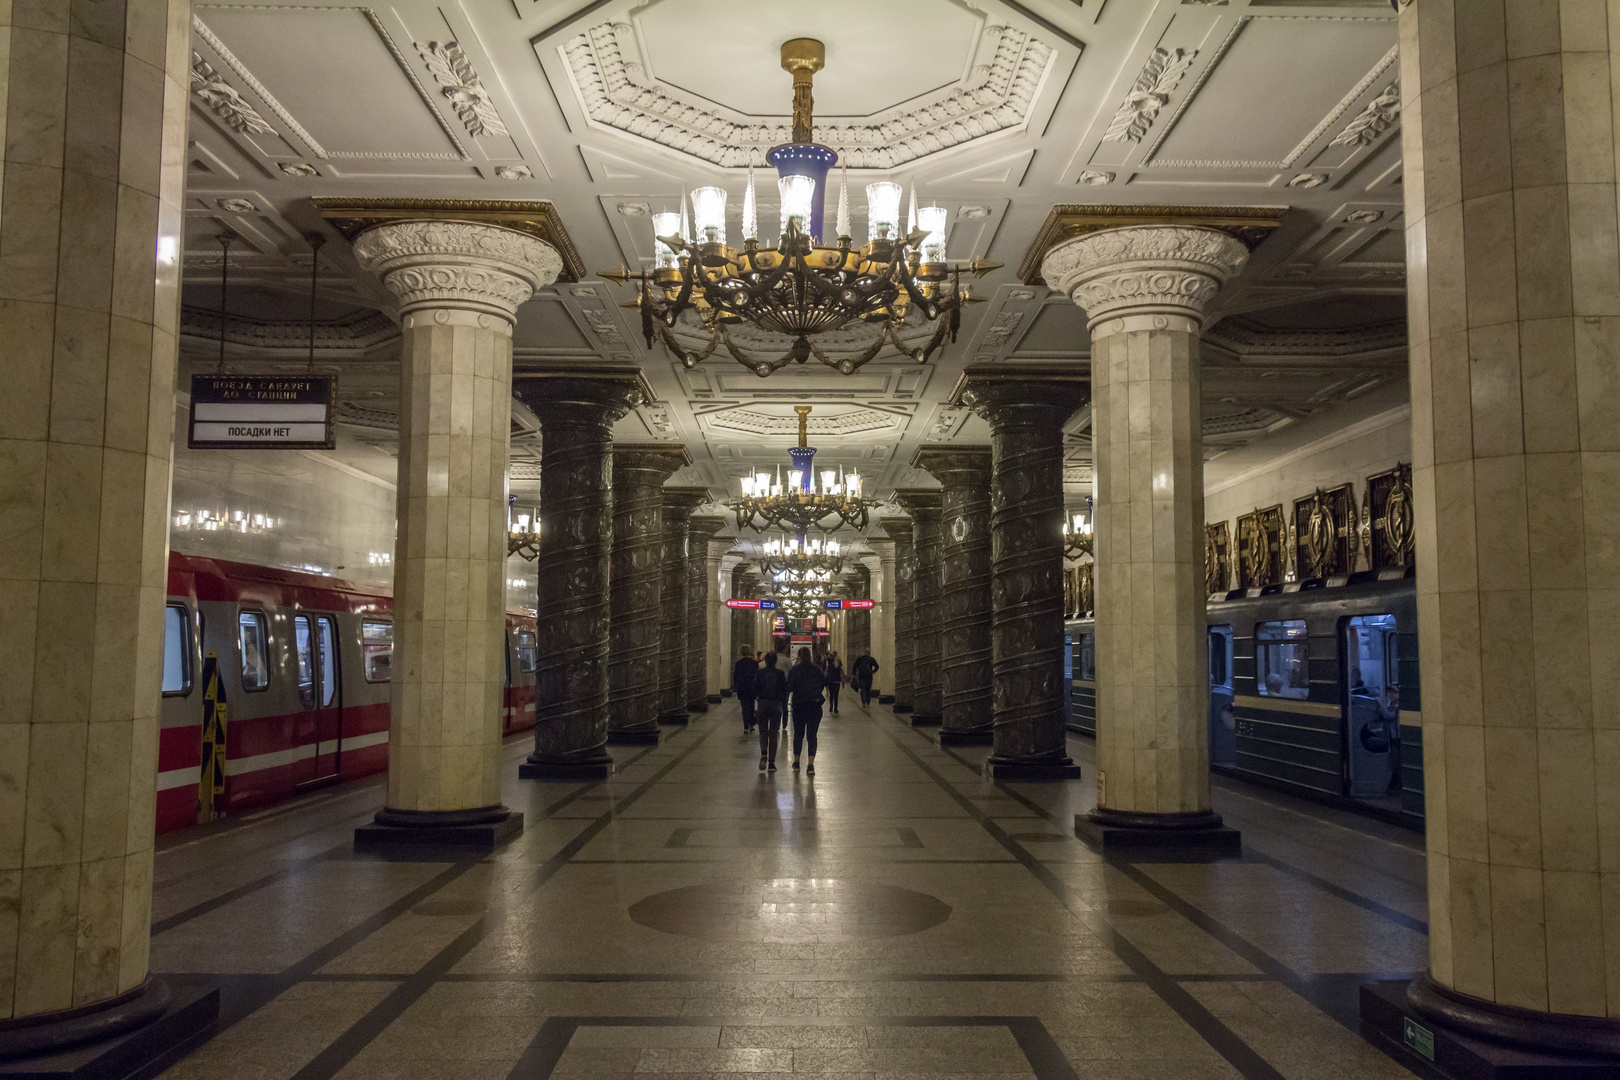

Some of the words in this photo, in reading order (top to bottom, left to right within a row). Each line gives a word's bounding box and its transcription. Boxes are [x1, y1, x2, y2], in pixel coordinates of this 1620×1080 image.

[260, 382, 311, 391] СЛЕДУЕТ
[223, 390, 239, 399] ДО
[248, 391, 297, 400] СТАНЦИИ
[228, 427, 271, 438] ПОСАДКИ
[273, 427, 290, 437] НЕТ
